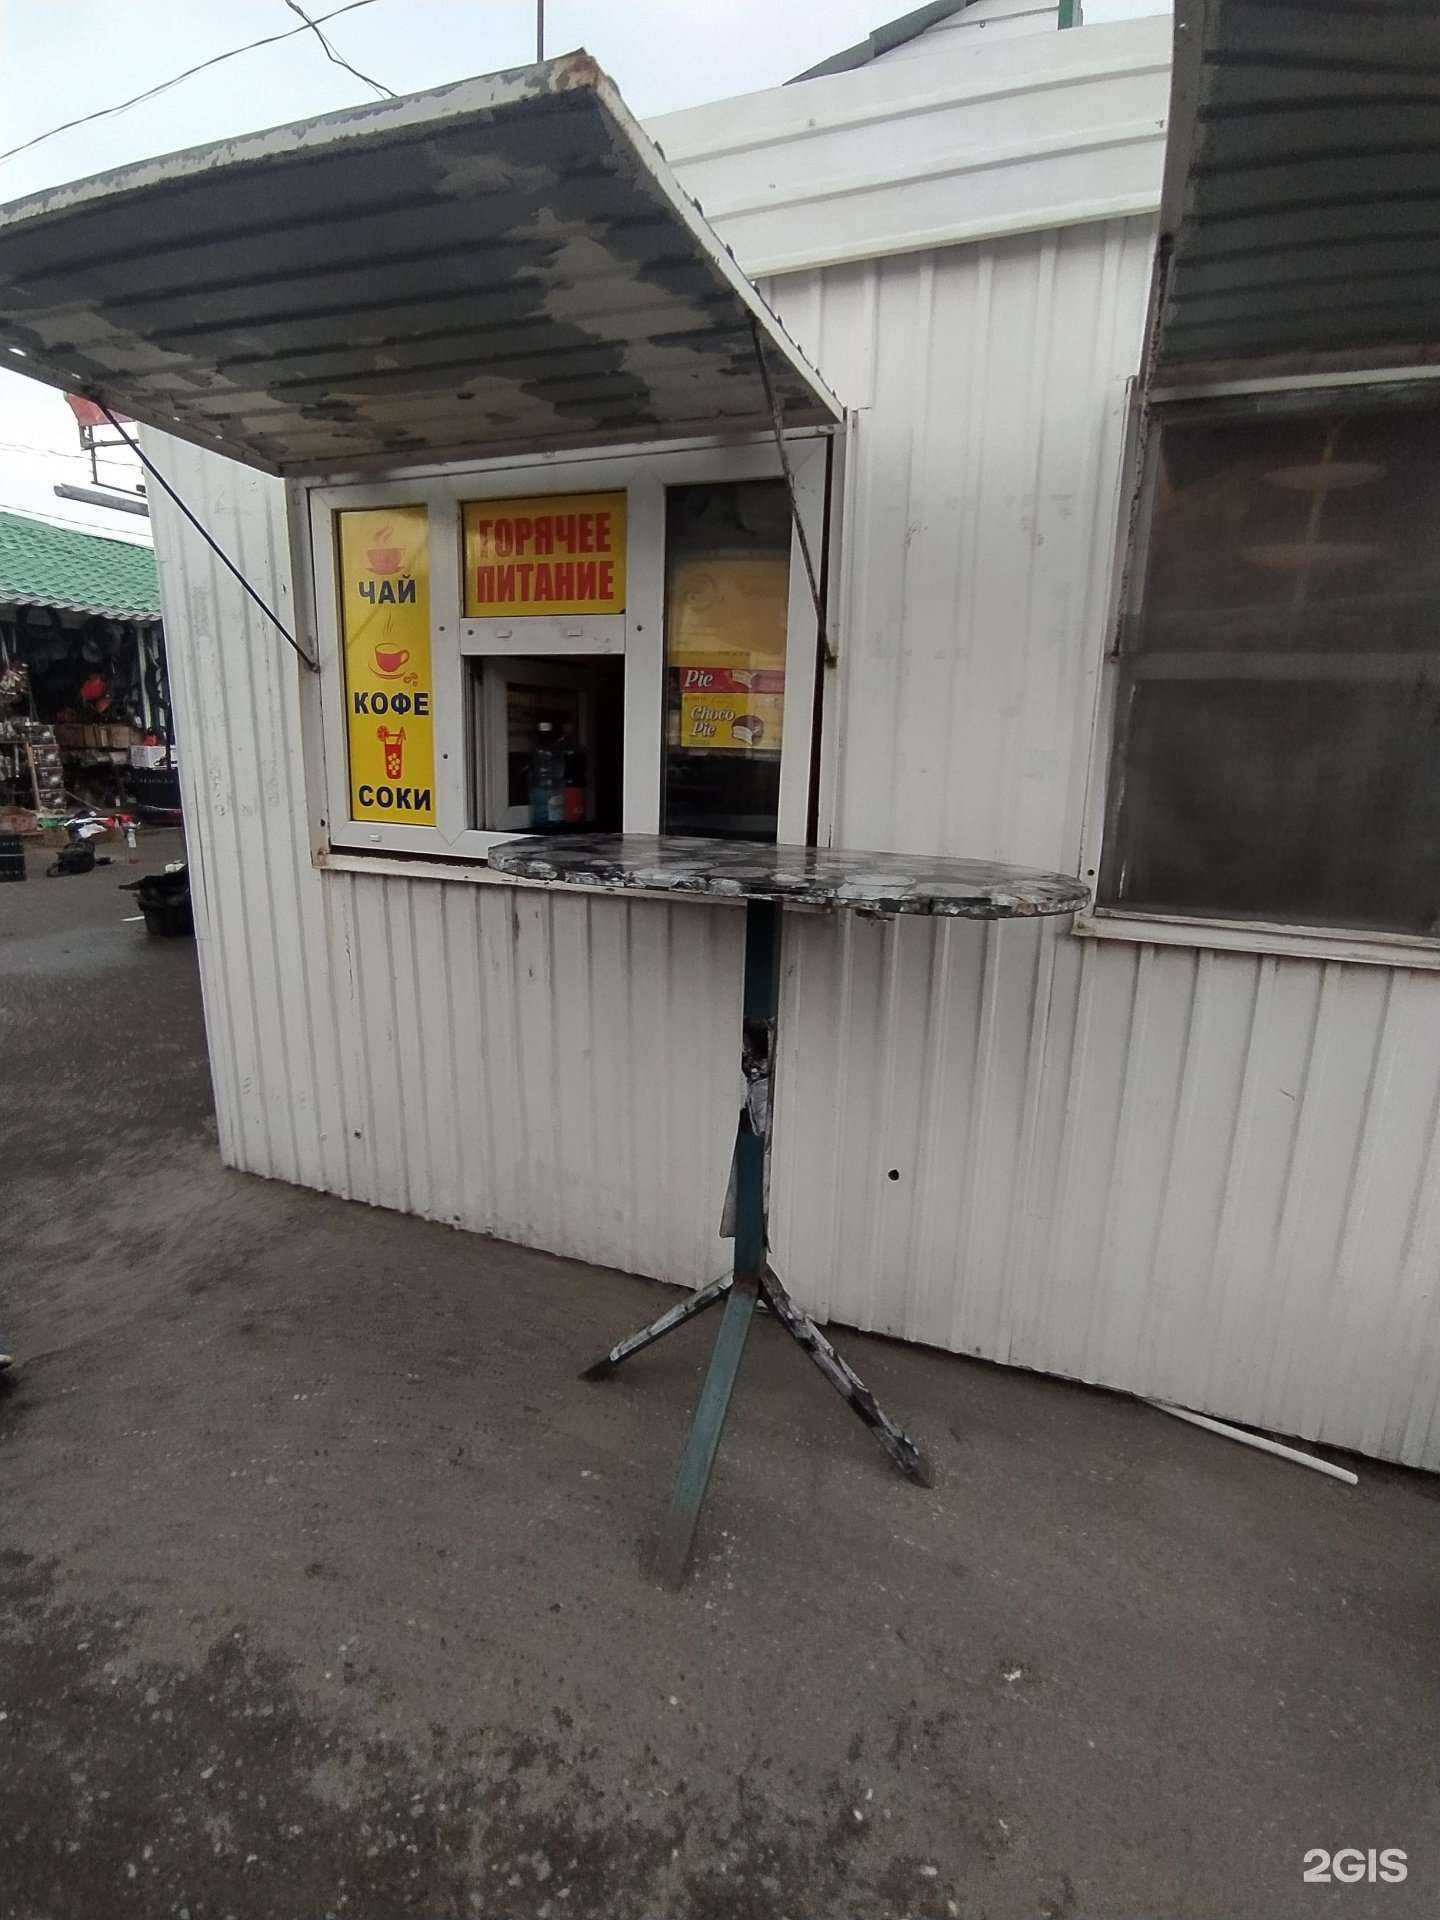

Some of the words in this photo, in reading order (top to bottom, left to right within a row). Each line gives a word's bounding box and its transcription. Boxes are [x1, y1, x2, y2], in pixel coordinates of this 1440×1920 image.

[479, 512, 612, 557] ГОРЯЧЕЕ
[359, 574, 416, 605] ЧАЙ
[477, 561, 615, 603] ПИТАНИЕ
[684, 669, 713, 688] Pie
[354, 692, 430, 716] КОФЕ
[690, 704, 735, 721] Choco
[690, 721, 716, 737] Pie
[358, 785, 431, 811] СОКИ
